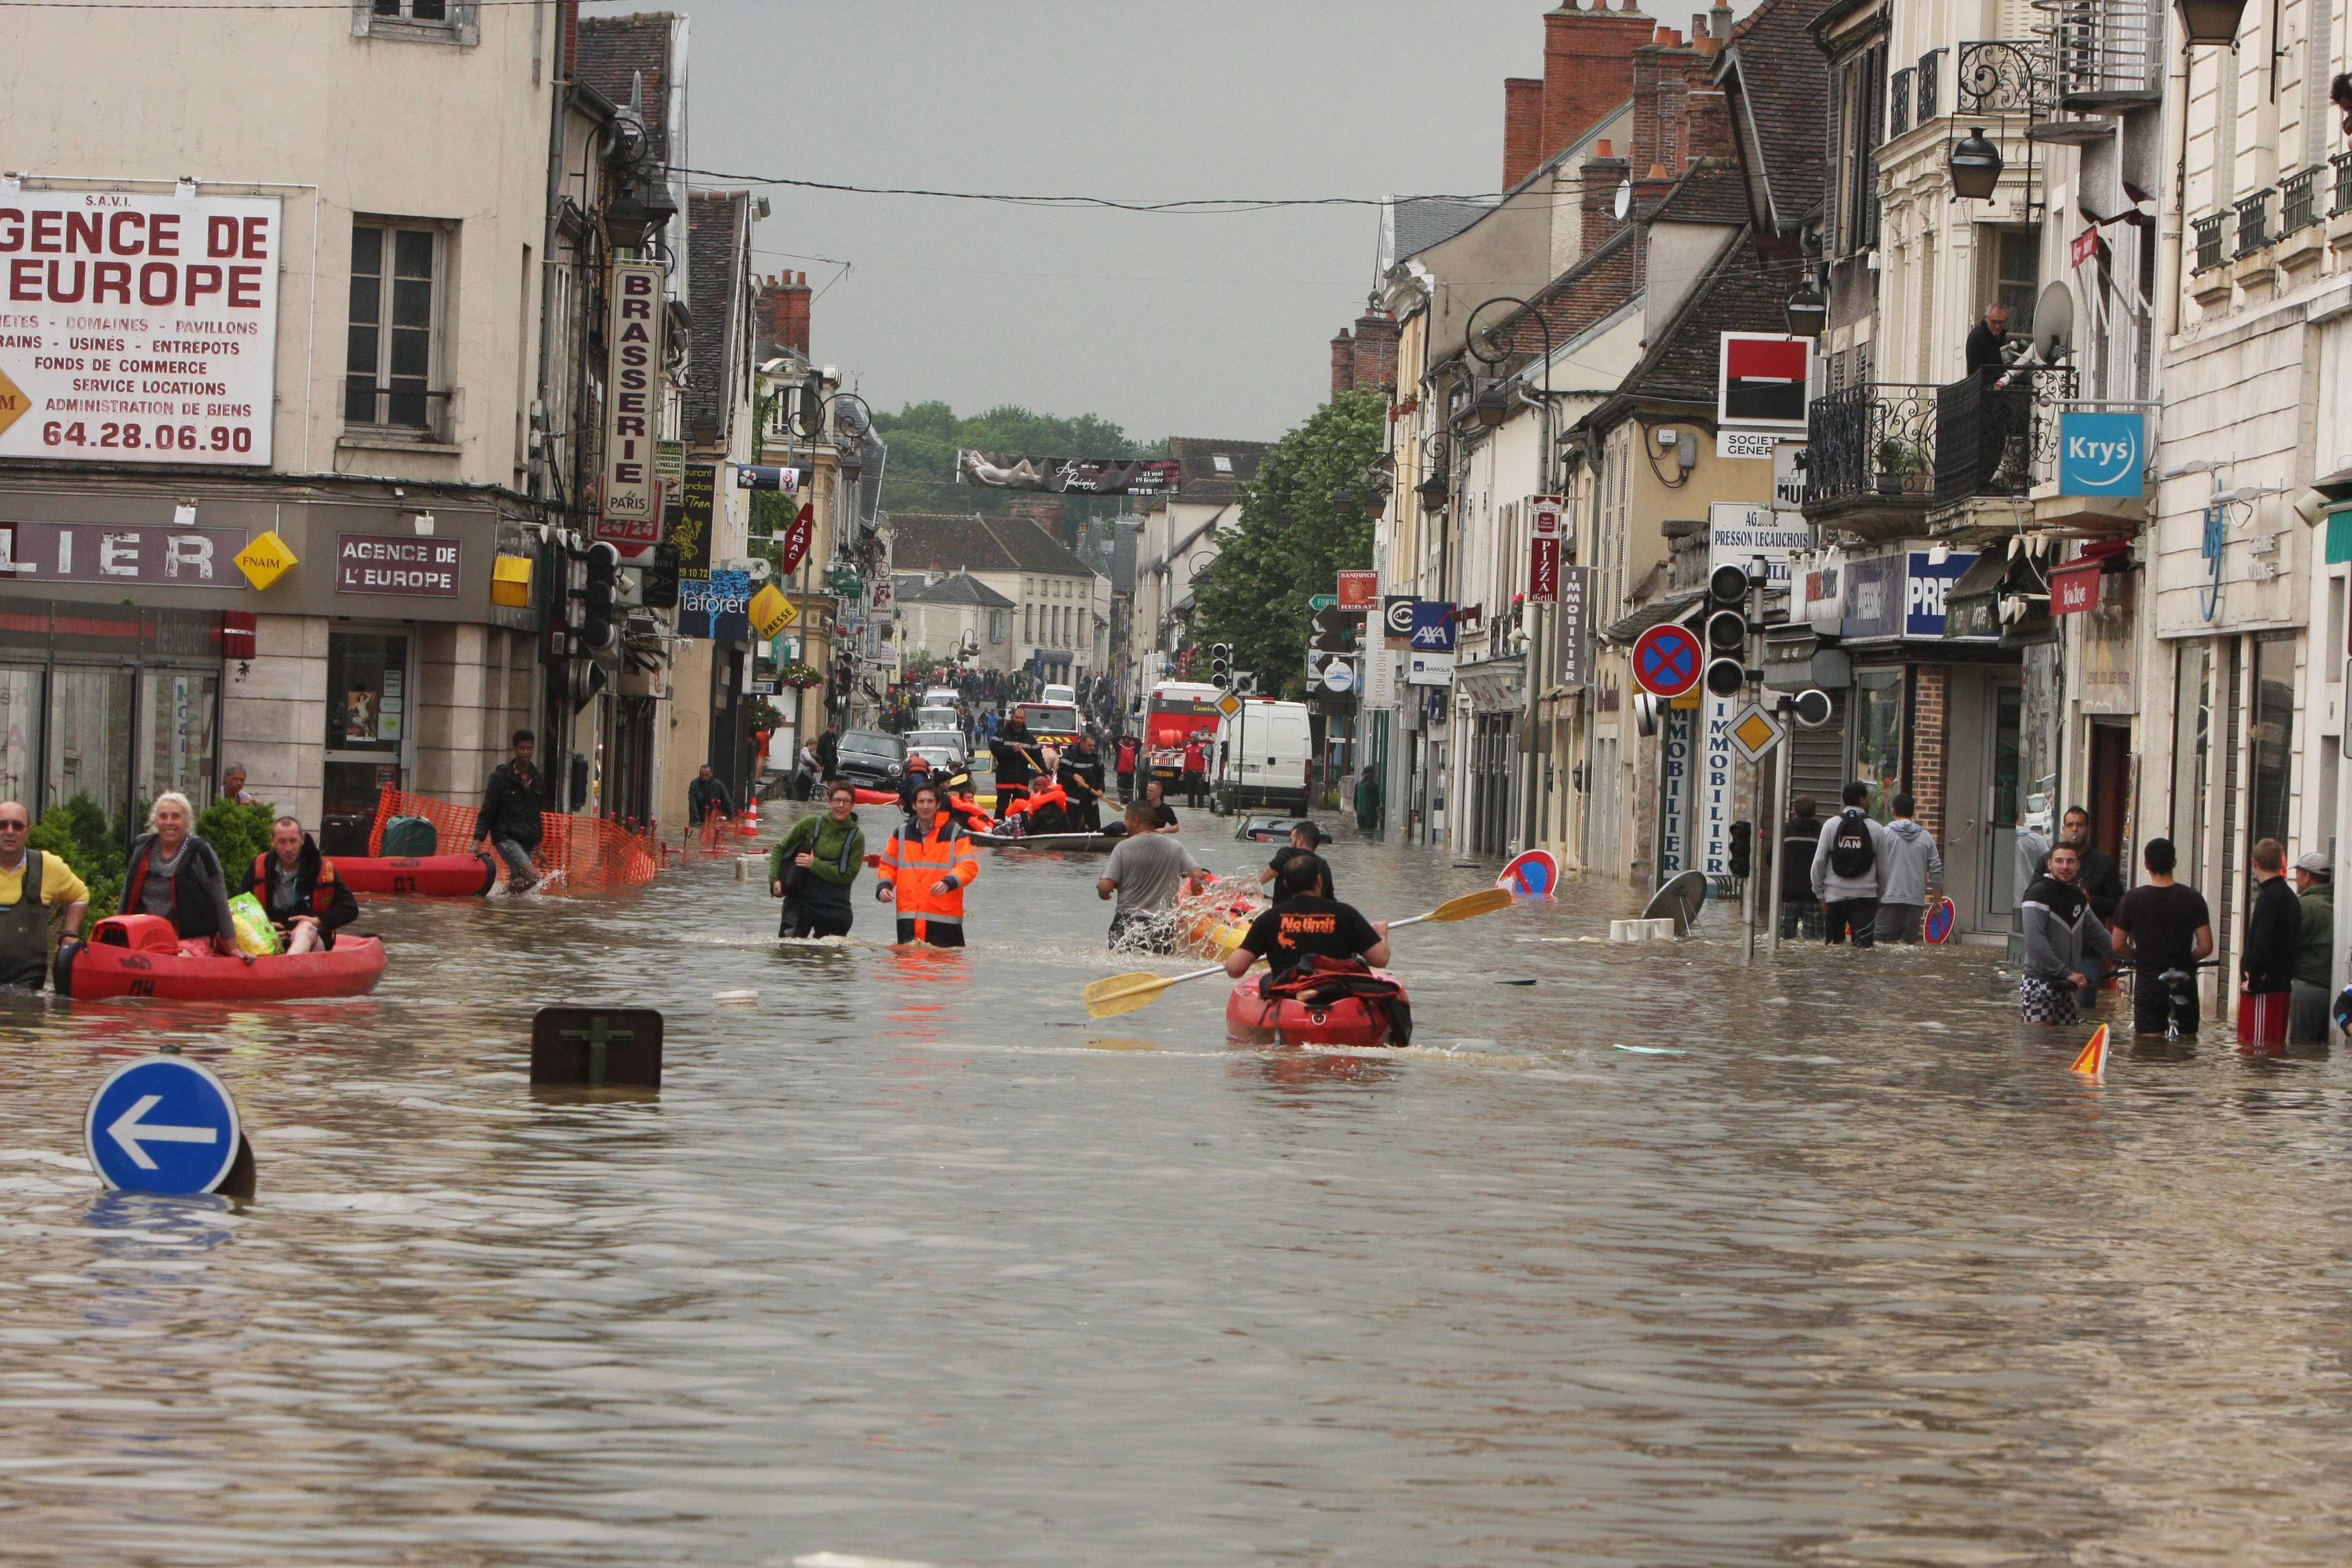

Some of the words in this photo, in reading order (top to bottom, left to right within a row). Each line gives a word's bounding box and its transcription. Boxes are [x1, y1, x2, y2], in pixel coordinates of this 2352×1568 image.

[86, 195, 131, 207] S.A.V.I.
[207, 215, 269, 260] DE
[9, 258, 262, 309] EUROPE
[66, 316, 149, 332] DOMAINES
[175, 320, 258, 335] PAVILLONS
[70, 338, 125, 352] USINES
[152, 340, 240, 355] ENTREPOTS
[34, 356, 85, 371] FONDS
[92, 358, 111, 371] DE
[119, 359, 207, 374] COMMERCE
[73, 379, 134, 393] SERVICE
[142, 381, 226, 396] LOCATIONS
[615, 275, 652, 483] BRASSERIE
[45, 397, 174, 416] ADMINISTRATION
[181, 401, 200, 416] DE
[207, 402, 252, 417] BIENS
[43, 421, 252, 452] 64.28.06.90
[2069, 436, 2128, 466] Krys
[610, 497, 645, 509] PARIS
[1745, 511, 1778, 527] AGE
[789, 519, 808, 560] TABAC
[1715, 531, 1753, 546] PRESSON
[1756, 532, 1808, 547] LECAUCHOIS
[342, 542, 427, 562] AGENCE
[436, 547, 456, 563] DE
[243, 556, 279, 569] FNAIM
[1538, 541, 1551, 592] PIZZA
[689, 568, 697, 577] 10
[699, 569, 708, 578] 72
[682, 593, 745, 613] laforêt
[1532, 593, 1553, 602] Grill
[763, 607, 792, 635] PRESSE
[1565, 571, 1581, 681] IMMOBILIER
[1411, 626, 1448, 644] AXA
[1707, 702, 1730, 872] IMMOBILIER
[1281, 917, 1301, 929] No
[1302, 917, 1335, 932] limit
